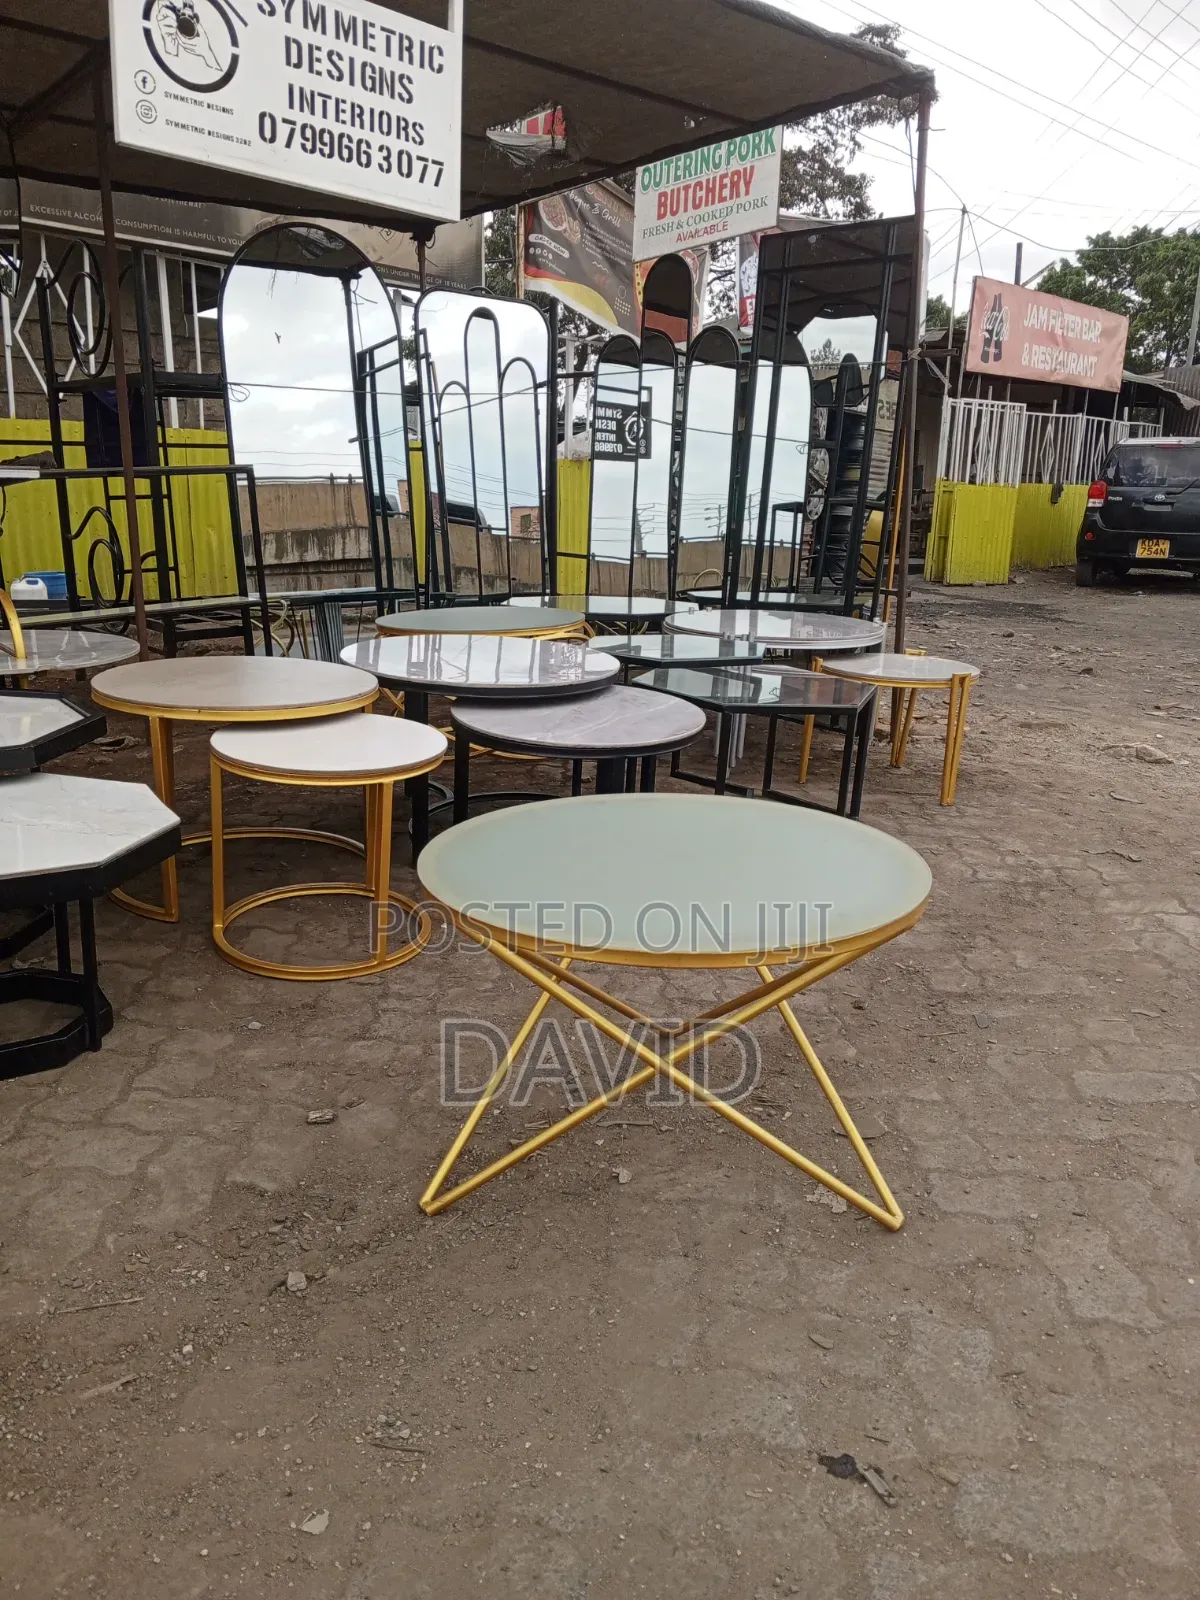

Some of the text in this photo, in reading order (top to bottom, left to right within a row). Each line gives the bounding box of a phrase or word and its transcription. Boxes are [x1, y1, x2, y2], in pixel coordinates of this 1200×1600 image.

[257, 0, 444, 74] SYMMETRIC
[285, 35, 414, 104] DESIGNS
[164, 91, 204, 107] SYMMETRIC
[288, 83, 424, 146] INTERIORS
[165, 118, 205, 135] SYMMETRIC
[258, 111, 444, 187] 0799663077
[641, 127, 777, 193] OUTERING PORK
[657, 165, 755, 221] BUTCHERY
[29, 204, 72, 218] EXCESSIVE
[74, 211, 103, 223] ALCOH
[115, 218, 172, 234] CONSUMPTION
[182, 231, 215, 242] HARMFUL
[216, 235, 227, 244] TO
[642, 196, 769, 239] FRESH & COOKED PORK
[676, 221, 729, 243] AVAILABLE
[1023, 303, 1049, 331] JAM
[1082, 317, 1102, 343] BAR
[1021, 343, 1098, 378] & RESTAURANT
[1140, 547, 1166, 556] 754N
